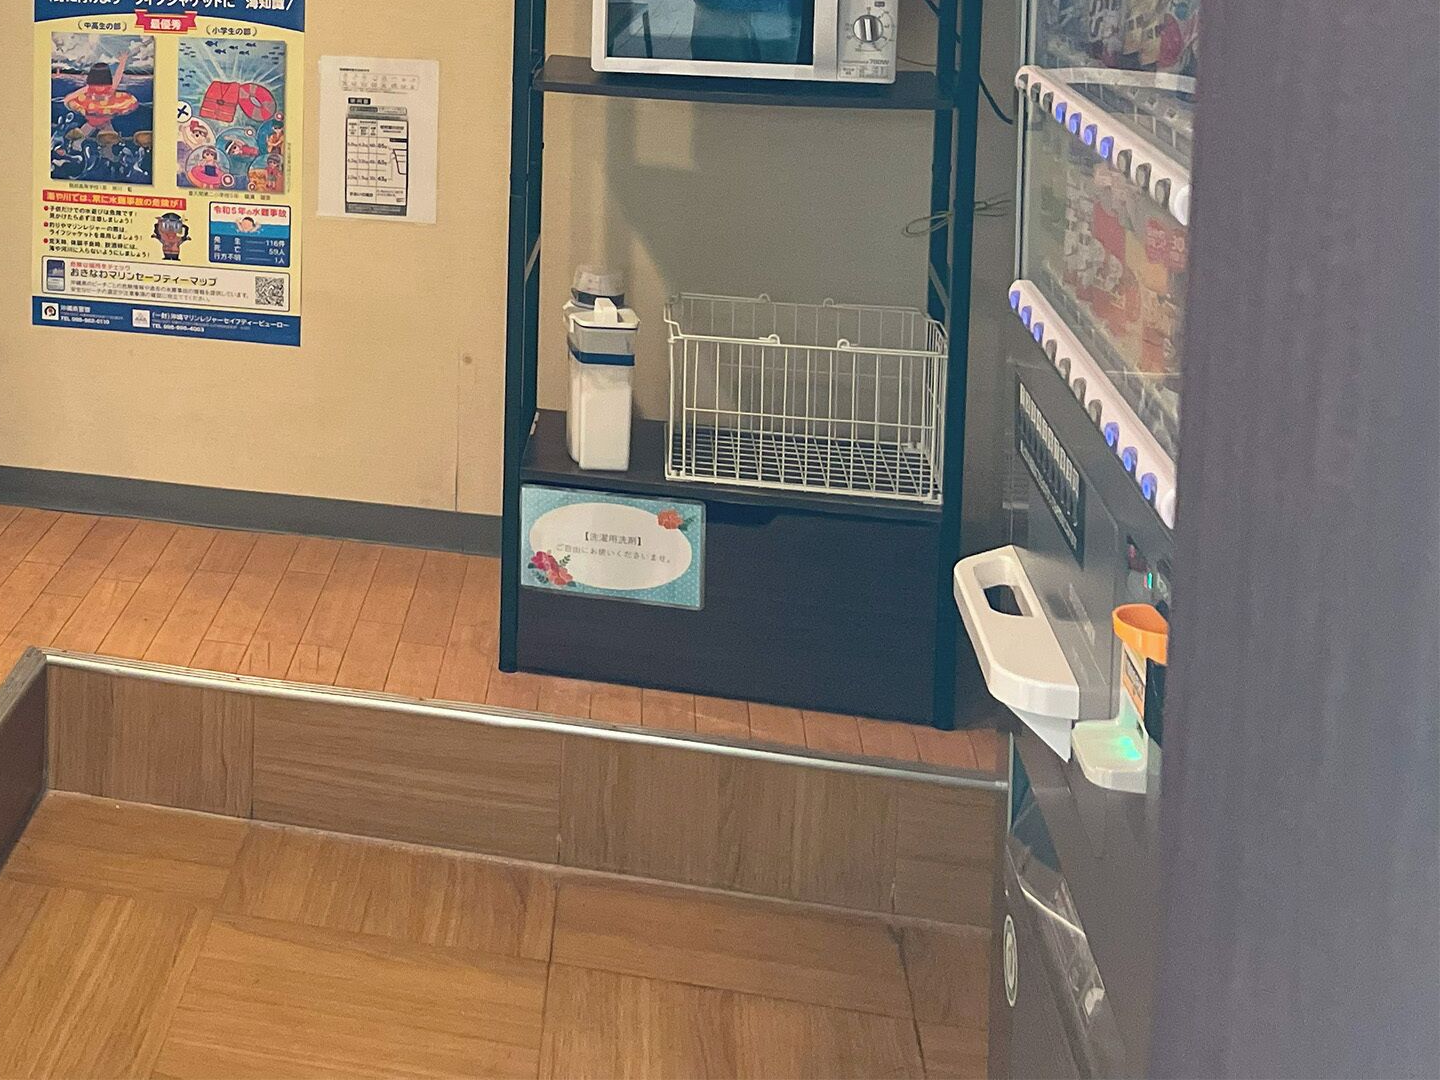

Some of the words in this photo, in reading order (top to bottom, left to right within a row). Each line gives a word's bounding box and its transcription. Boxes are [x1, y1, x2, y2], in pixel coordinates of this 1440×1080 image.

[213, 205, 287, 218] 令和5年の水難事故
[70, 267, 218, 287] おきなわマリンセーフティーマップ
